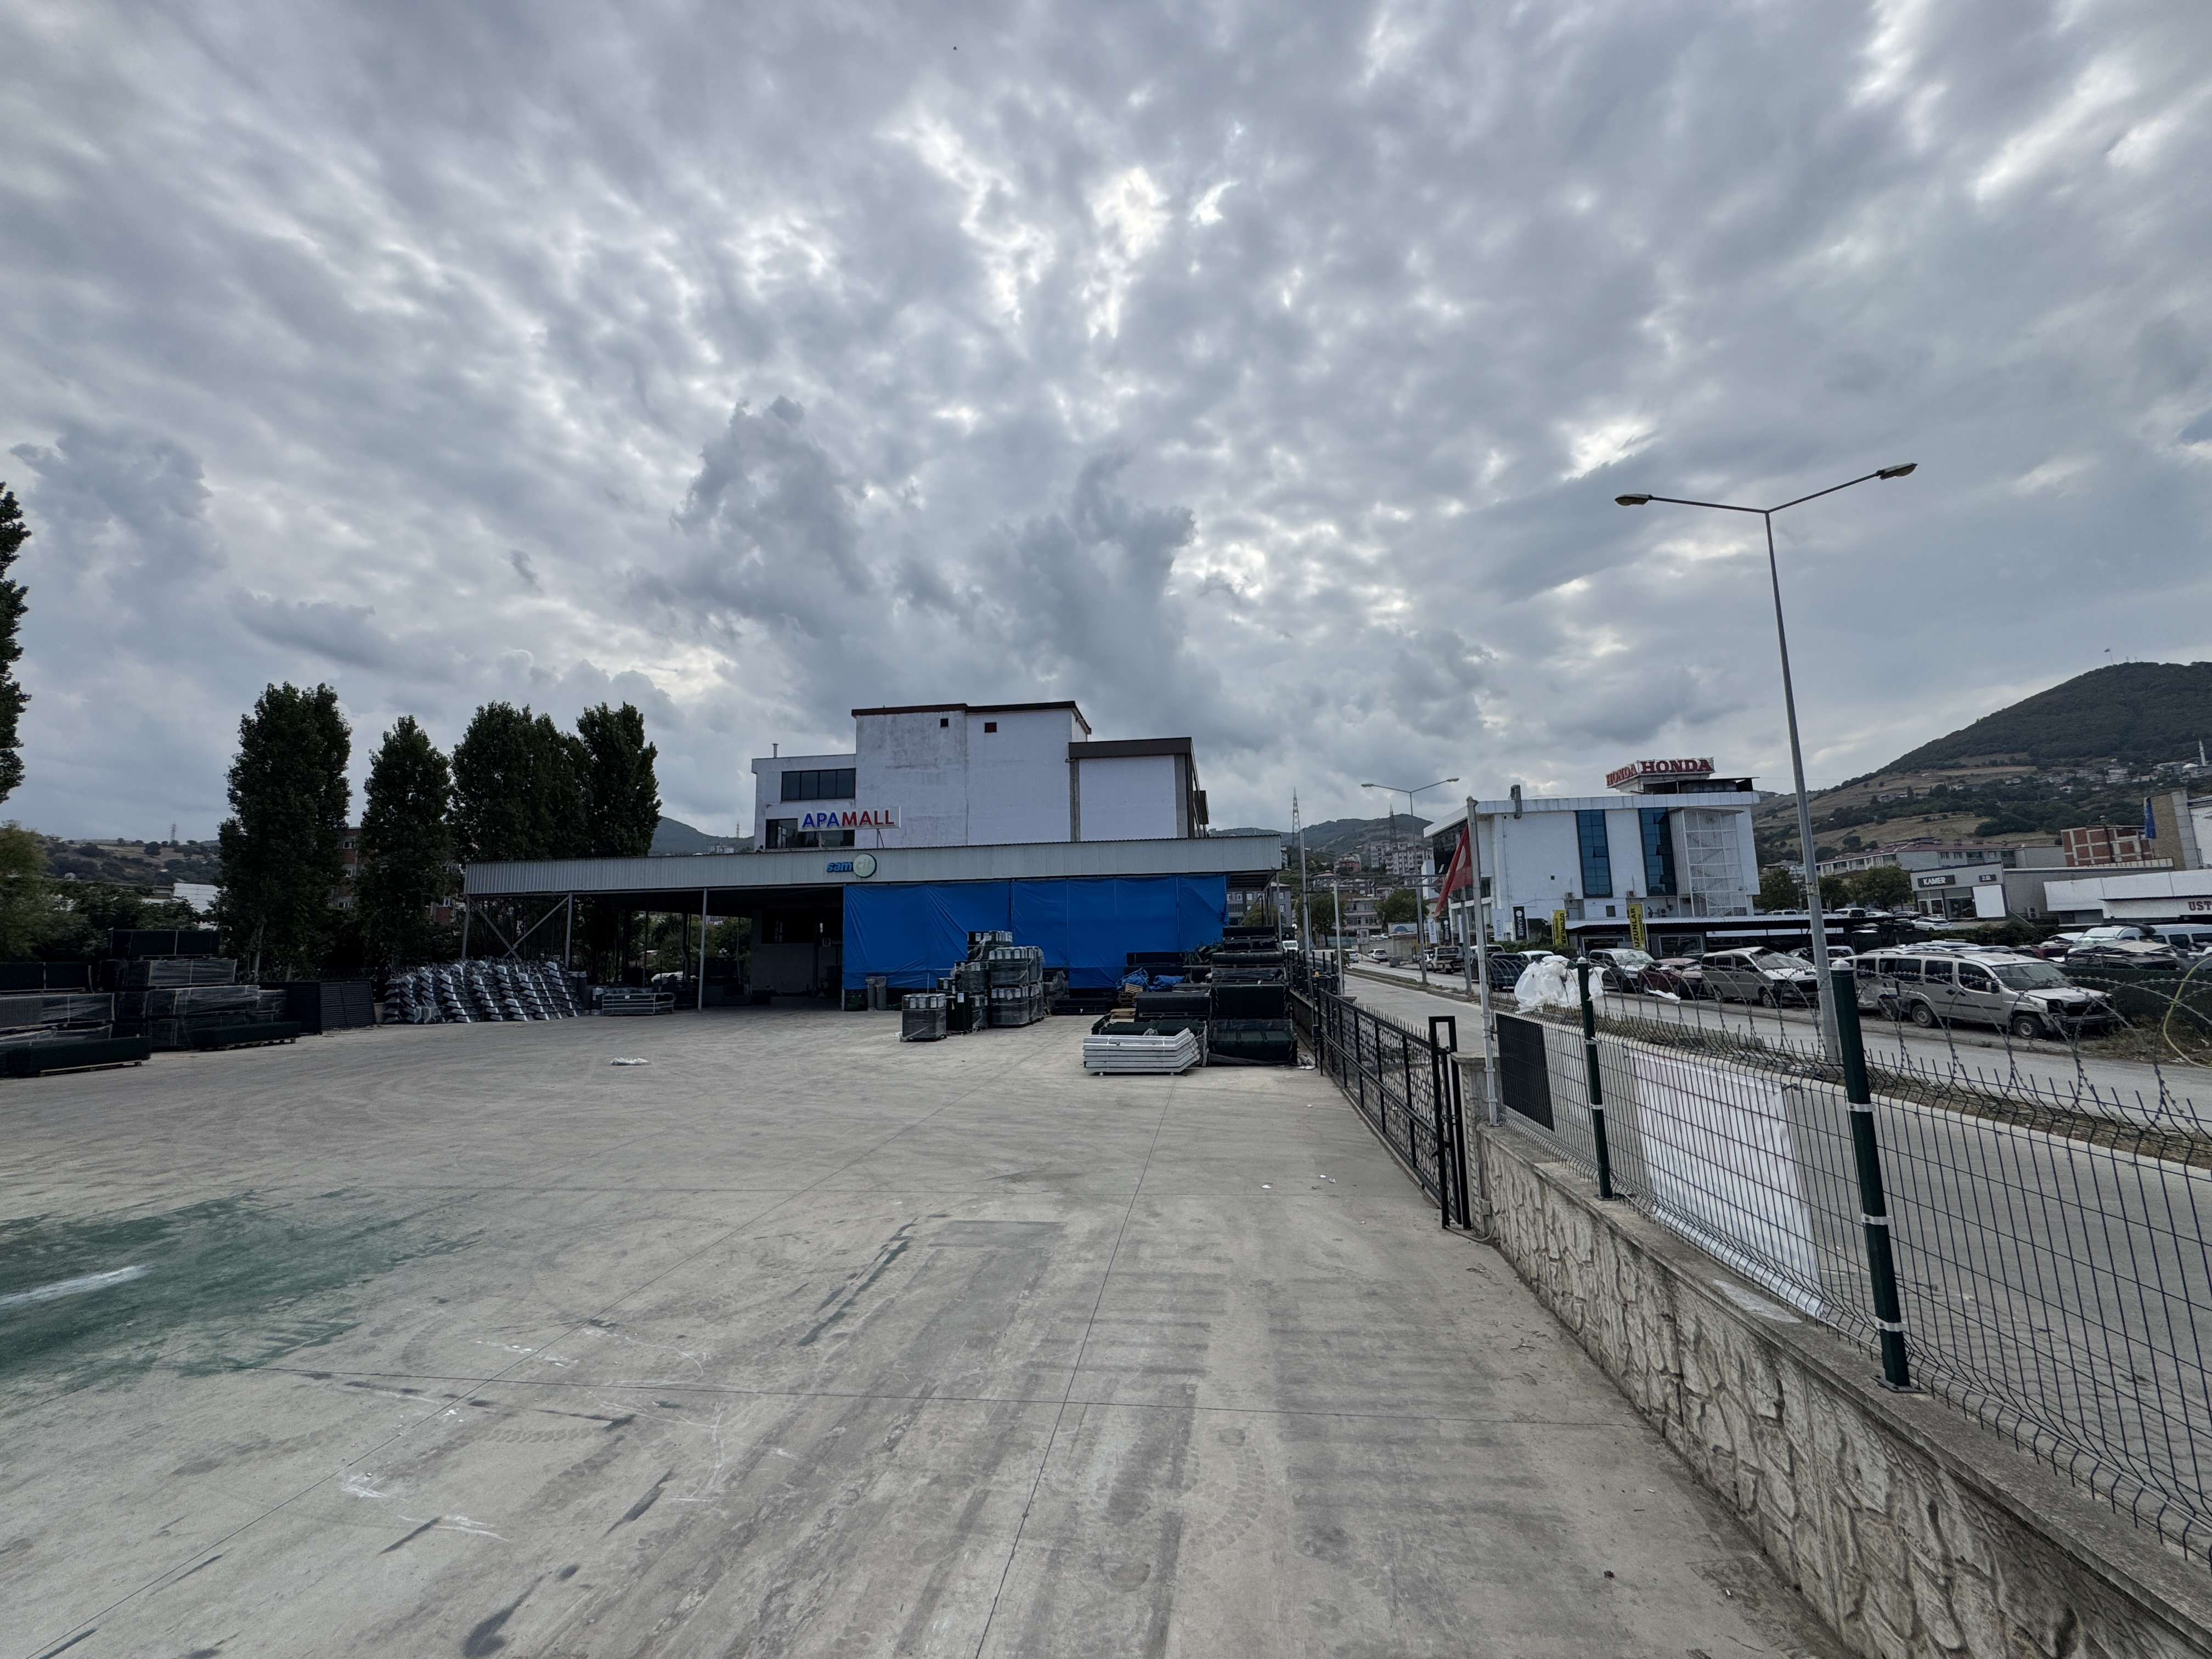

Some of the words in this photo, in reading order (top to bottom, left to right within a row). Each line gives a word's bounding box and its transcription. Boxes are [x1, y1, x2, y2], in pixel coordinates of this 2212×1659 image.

[1606, 764, 1638, 786] HONDA
[1641, 759, 1713, 774] HONDA
[802, 810, 894, 828] APAMALL
[1630, 908, 1639, 947] UZUNLAR
